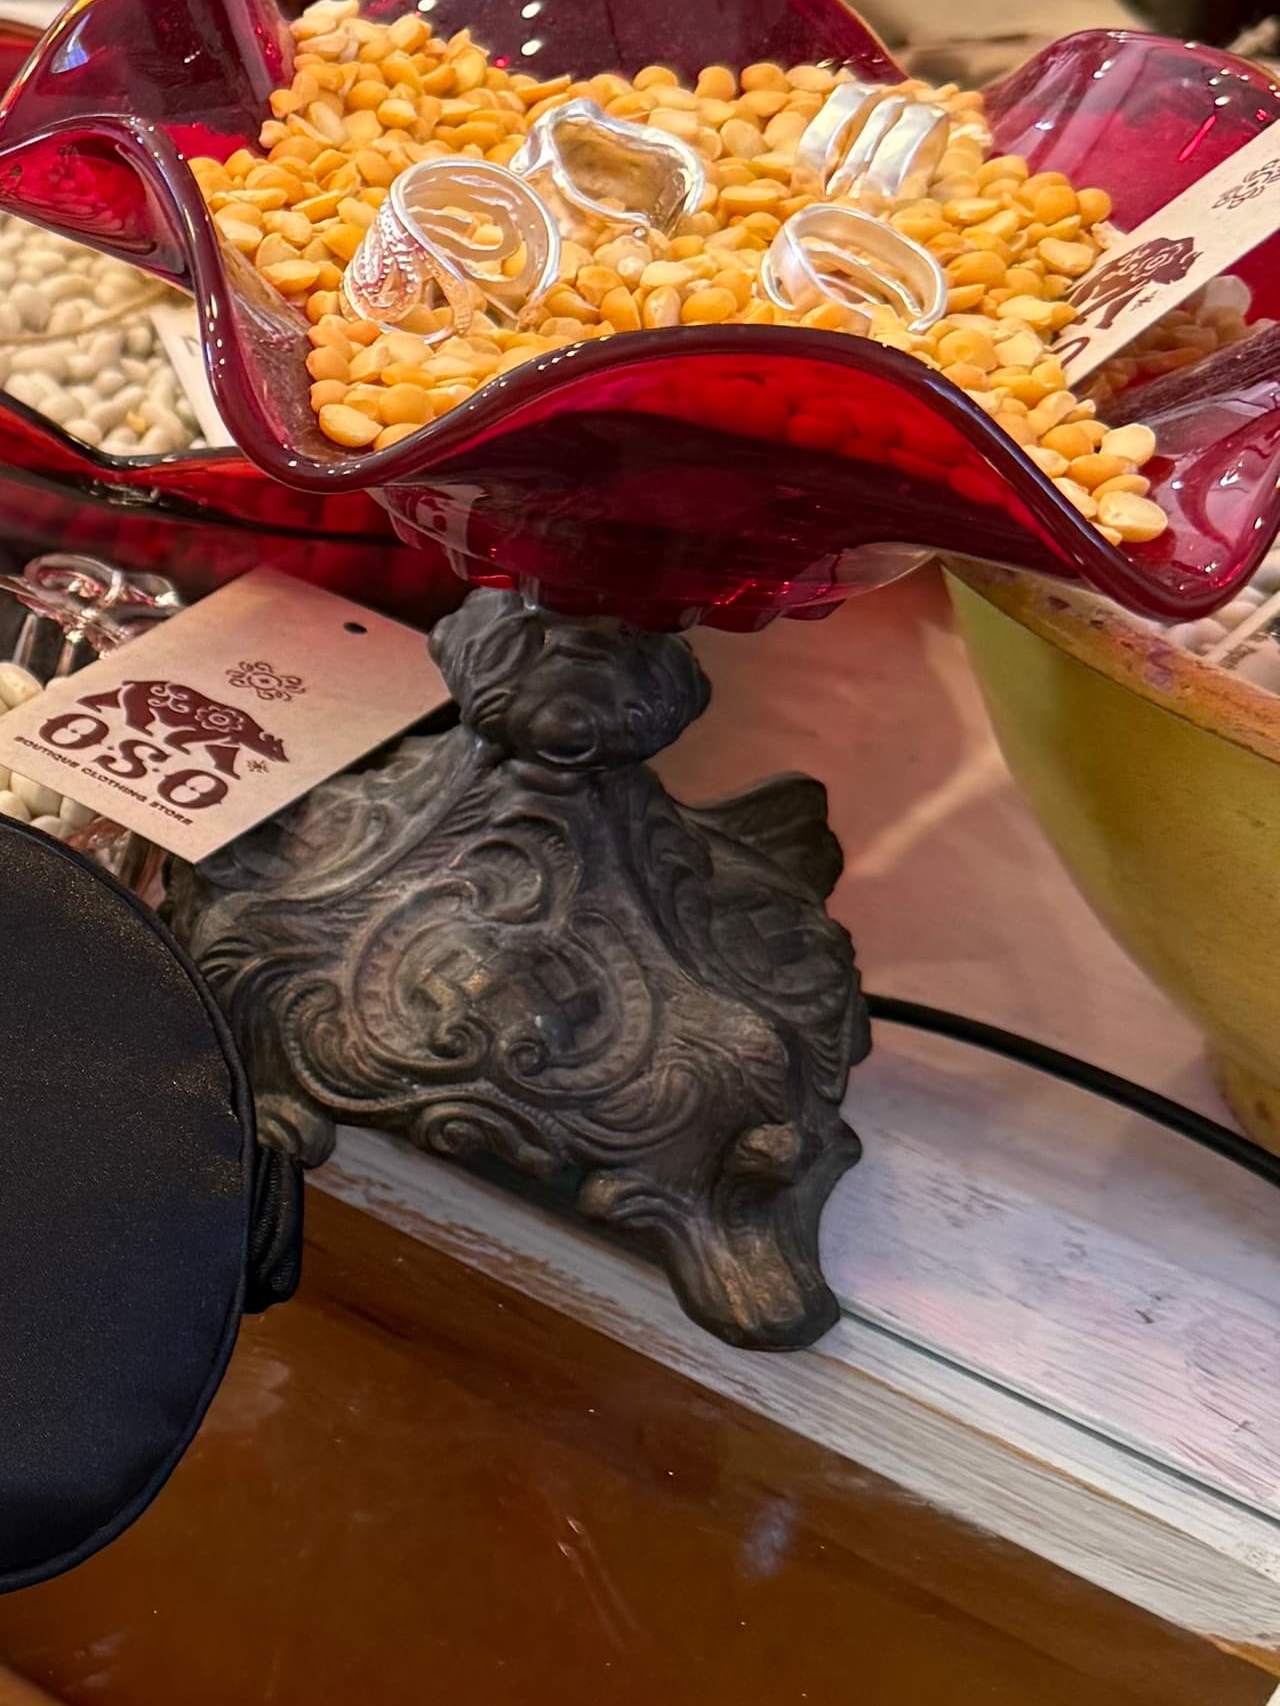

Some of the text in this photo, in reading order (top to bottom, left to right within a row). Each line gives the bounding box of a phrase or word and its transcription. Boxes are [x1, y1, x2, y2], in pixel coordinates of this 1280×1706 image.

[13, 735, 194, 827] BOUTIQUE CLOTHING STORE
